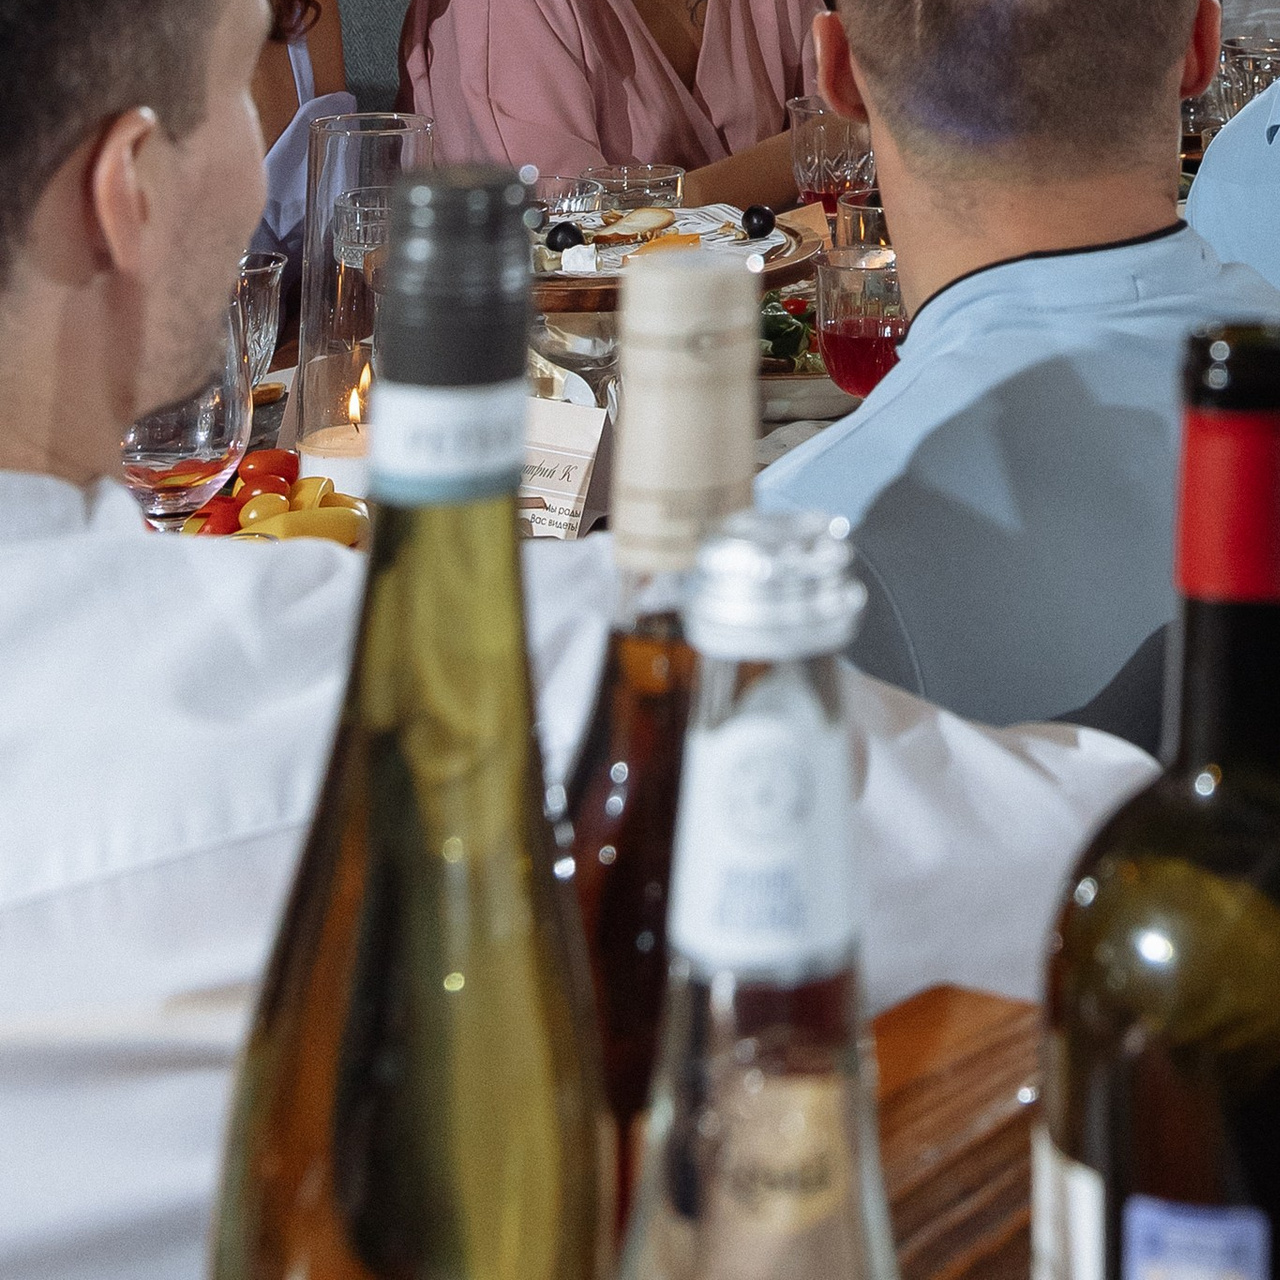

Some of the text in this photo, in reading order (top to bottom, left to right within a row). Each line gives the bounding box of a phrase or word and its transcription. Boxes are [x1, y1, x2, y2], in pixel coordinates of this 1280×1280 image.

[521, 459, 560, 482] итрий
[558, 507, 581, 518] рады
[530, 513, 579, 532] Вас видеть!
